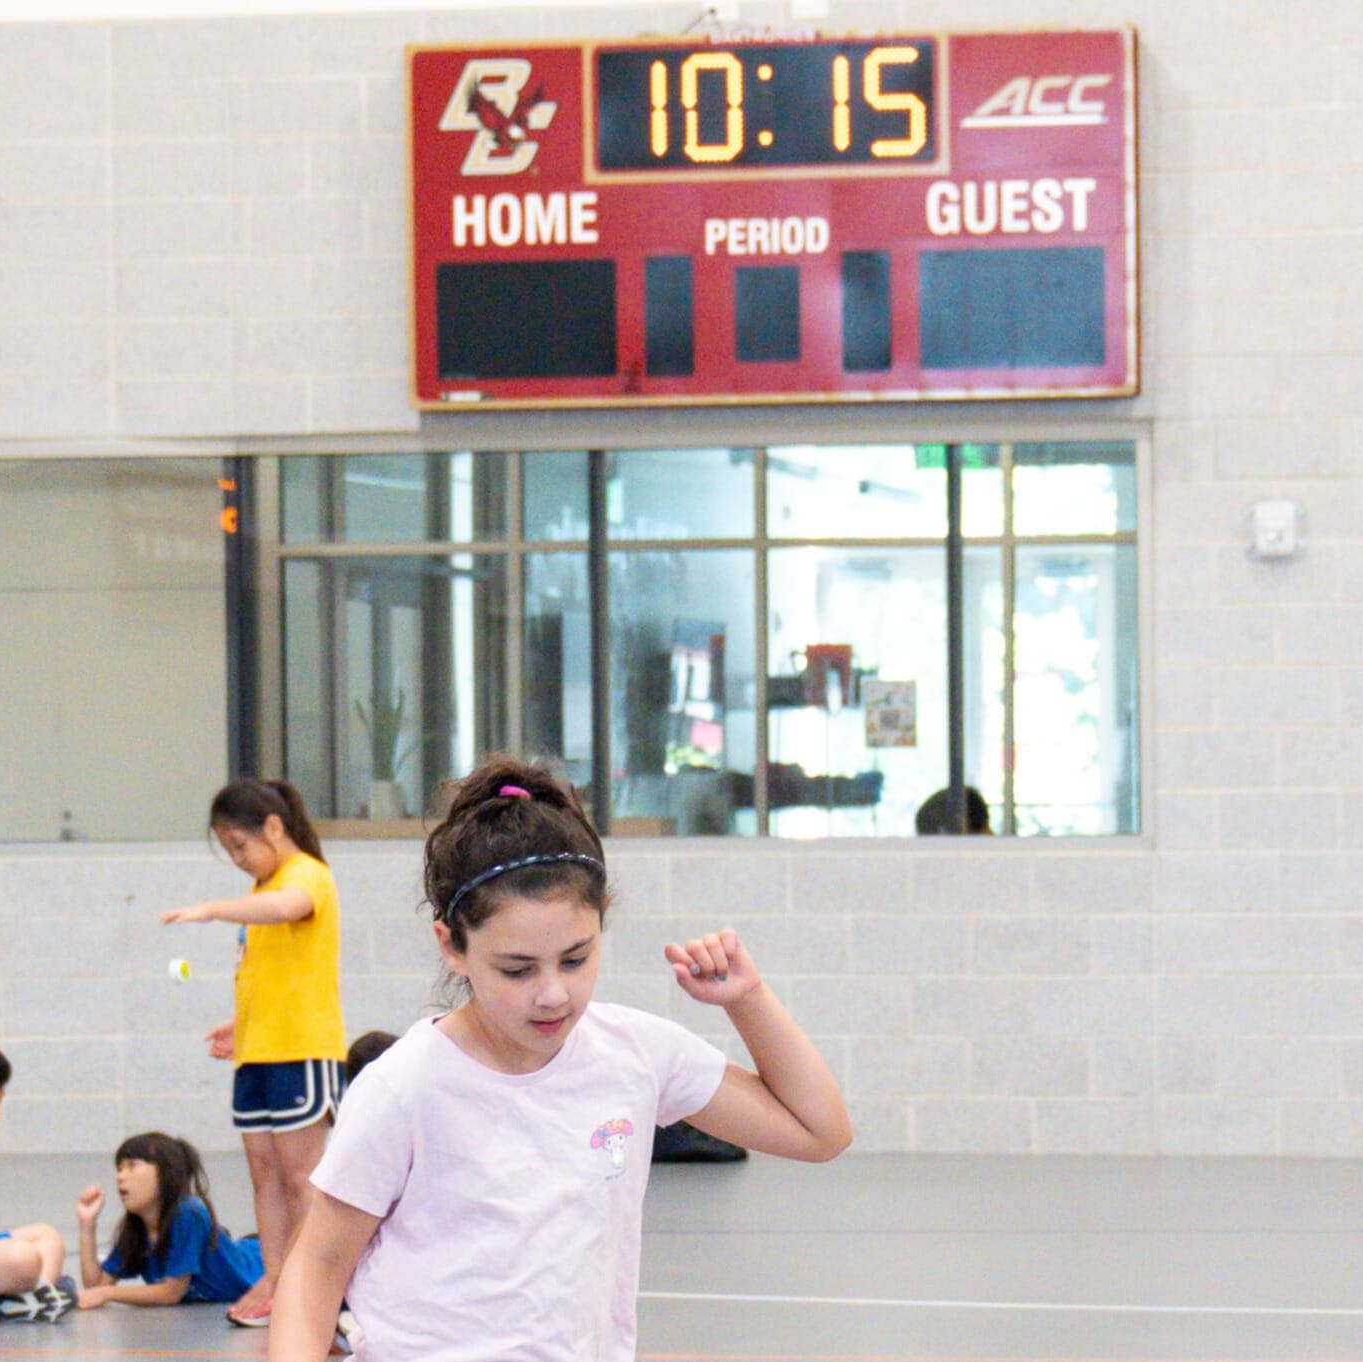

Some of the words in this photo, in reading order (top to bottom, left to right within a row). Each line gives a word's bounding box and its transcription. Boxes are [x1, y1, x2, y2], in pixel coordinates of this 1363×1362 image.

[650, 46, 926, 162] 10:15
[972, 74, 1113, 116] ACC
[452, 192, 599, 247] HOME
[925, 177, 1097, 235] GUEST
[704, 217, 830, 255] PERIOD
